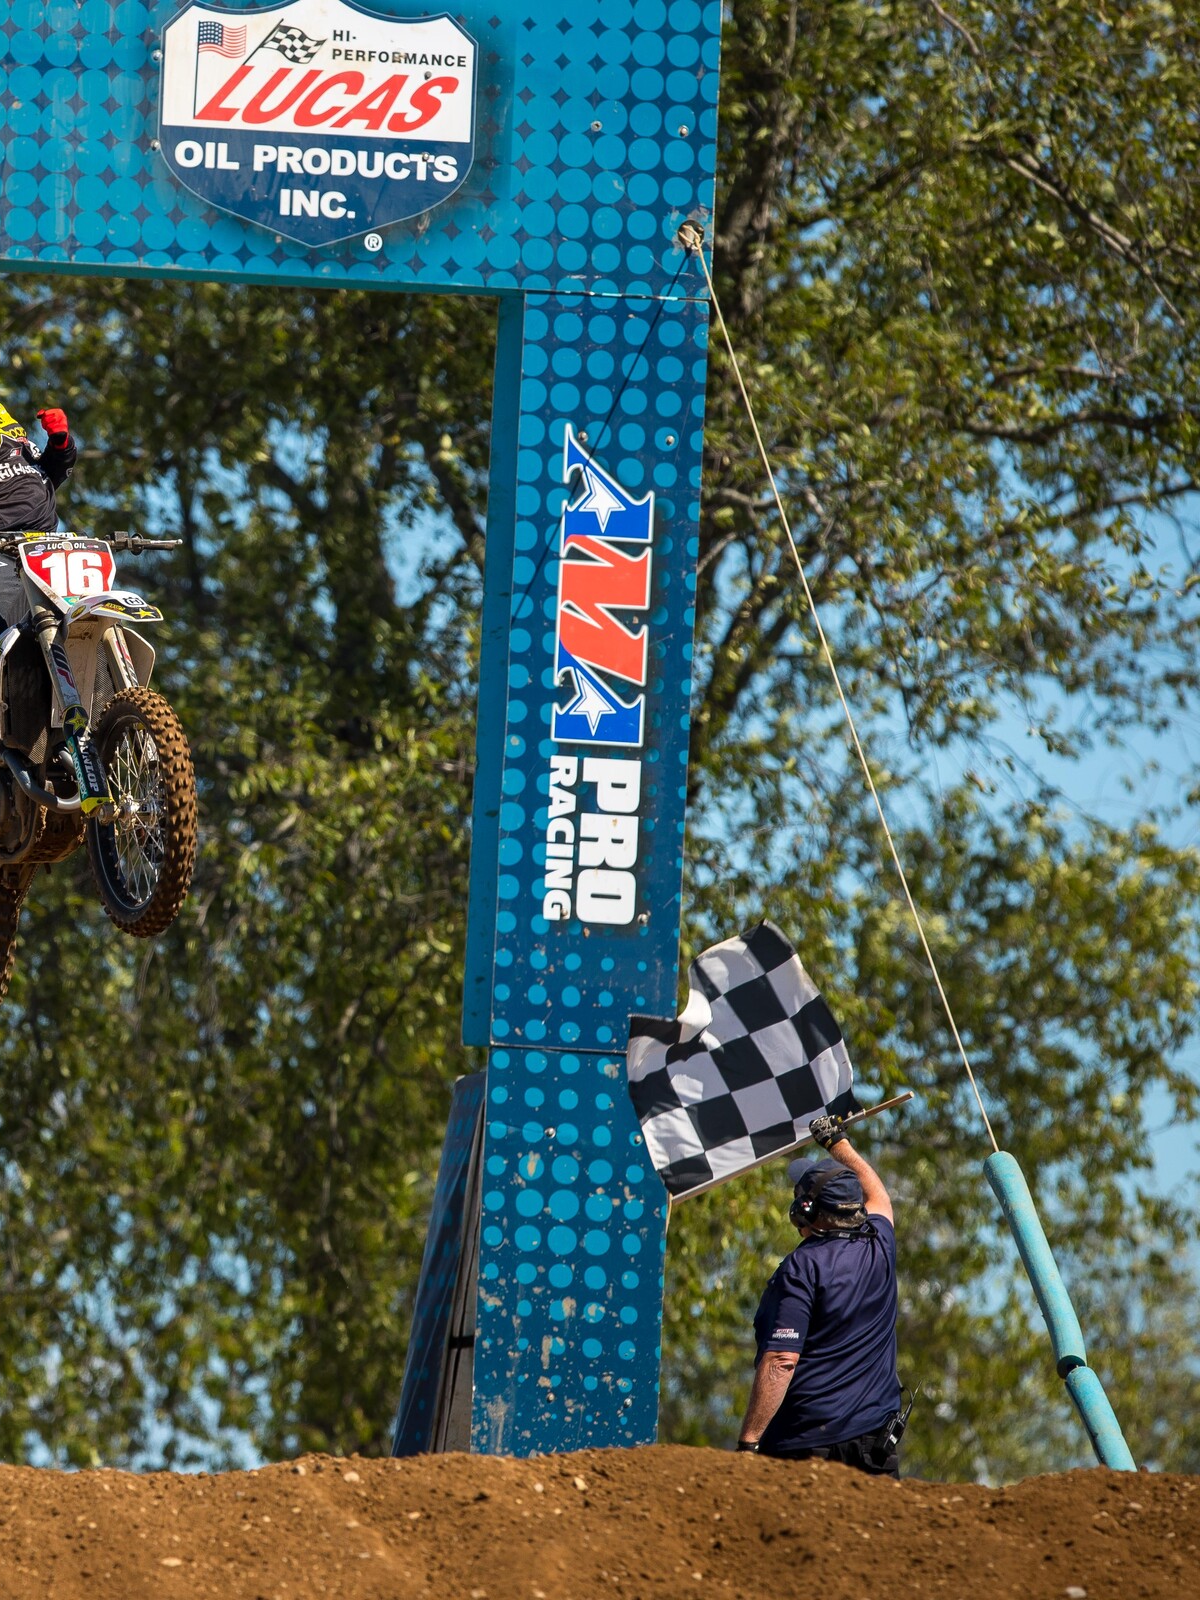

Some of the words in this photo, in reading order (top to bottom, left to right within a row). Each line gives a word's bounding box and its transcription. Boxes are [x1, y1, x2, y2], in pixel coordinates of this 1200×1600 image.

[332, 48, 467, 68] PERFORMANCE
[194, 65, 460, 133] LUCAS
[174, 140, 240, 170] OIL
[253, 144, 459, 183] PRODUCTS
[279, 188, 356, 219] INC.
[42, 551, 103, 597] 16
[550, 422, 654, 748] AMA
[542, 755, 579, 922] RACING
[576, 757, 641, 925] PRO
